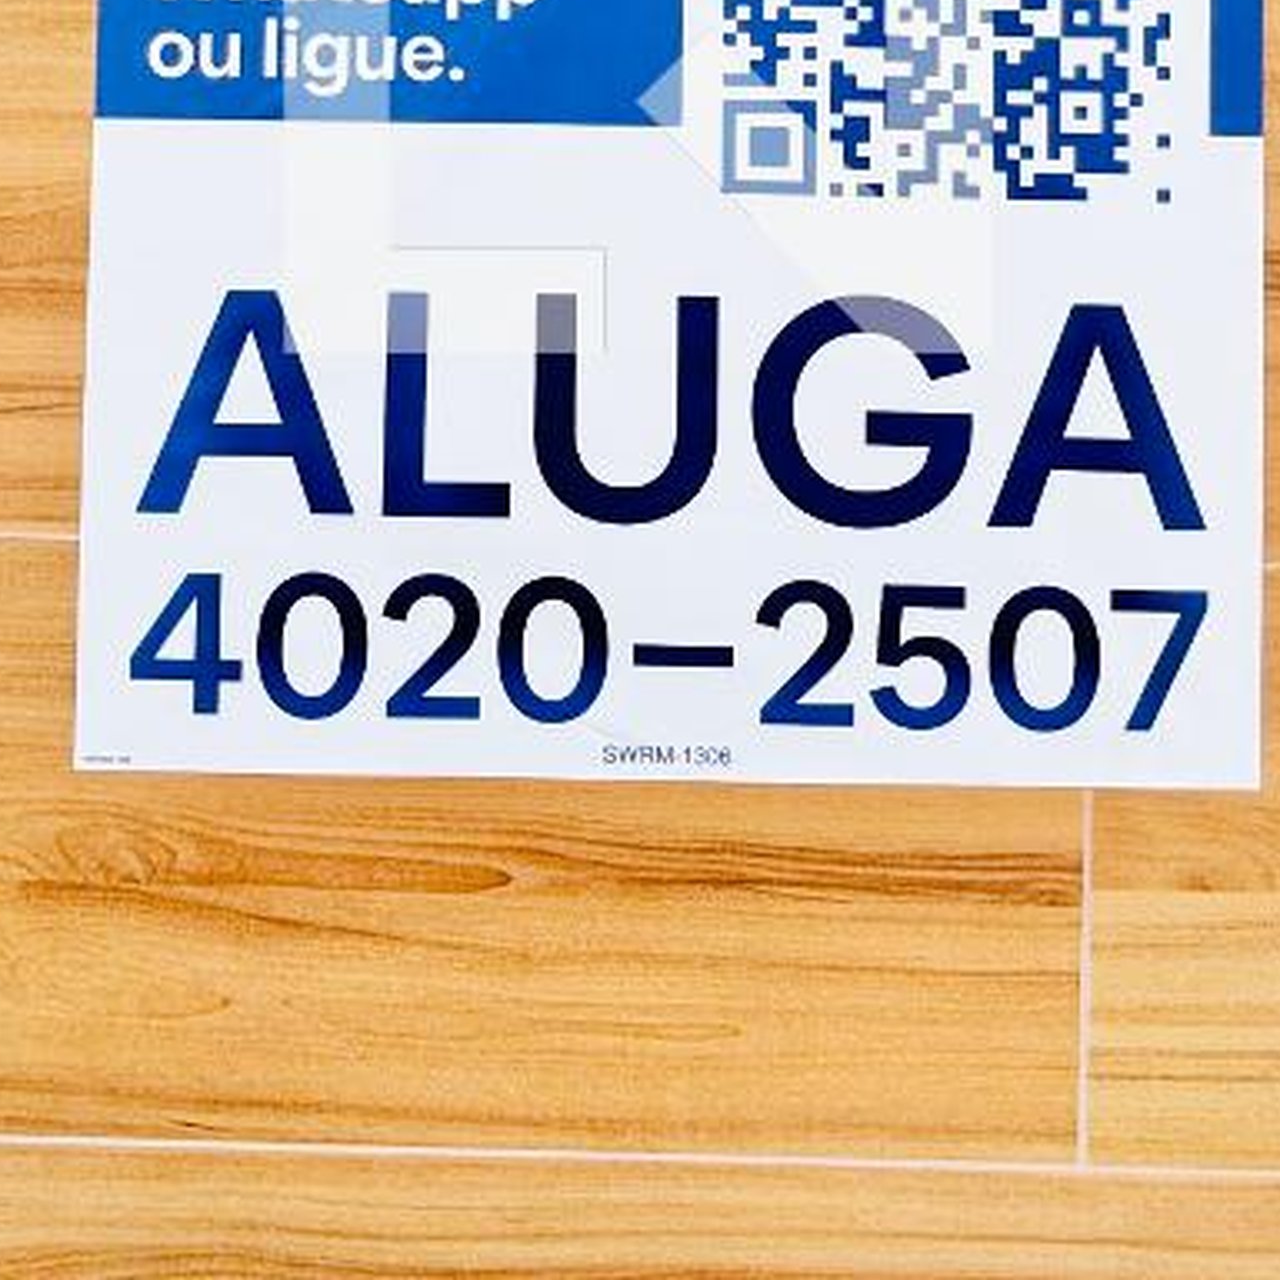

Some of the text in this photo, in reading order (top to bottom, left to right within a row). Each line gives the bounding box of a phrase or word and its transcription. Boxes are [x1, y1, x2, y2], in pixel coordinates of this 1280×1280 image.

[147, 16, 466, 95] ou ligue.
[135, 289, 1208, 531] ALUGA
[128, 572, 1211, 732] 4020-2507
